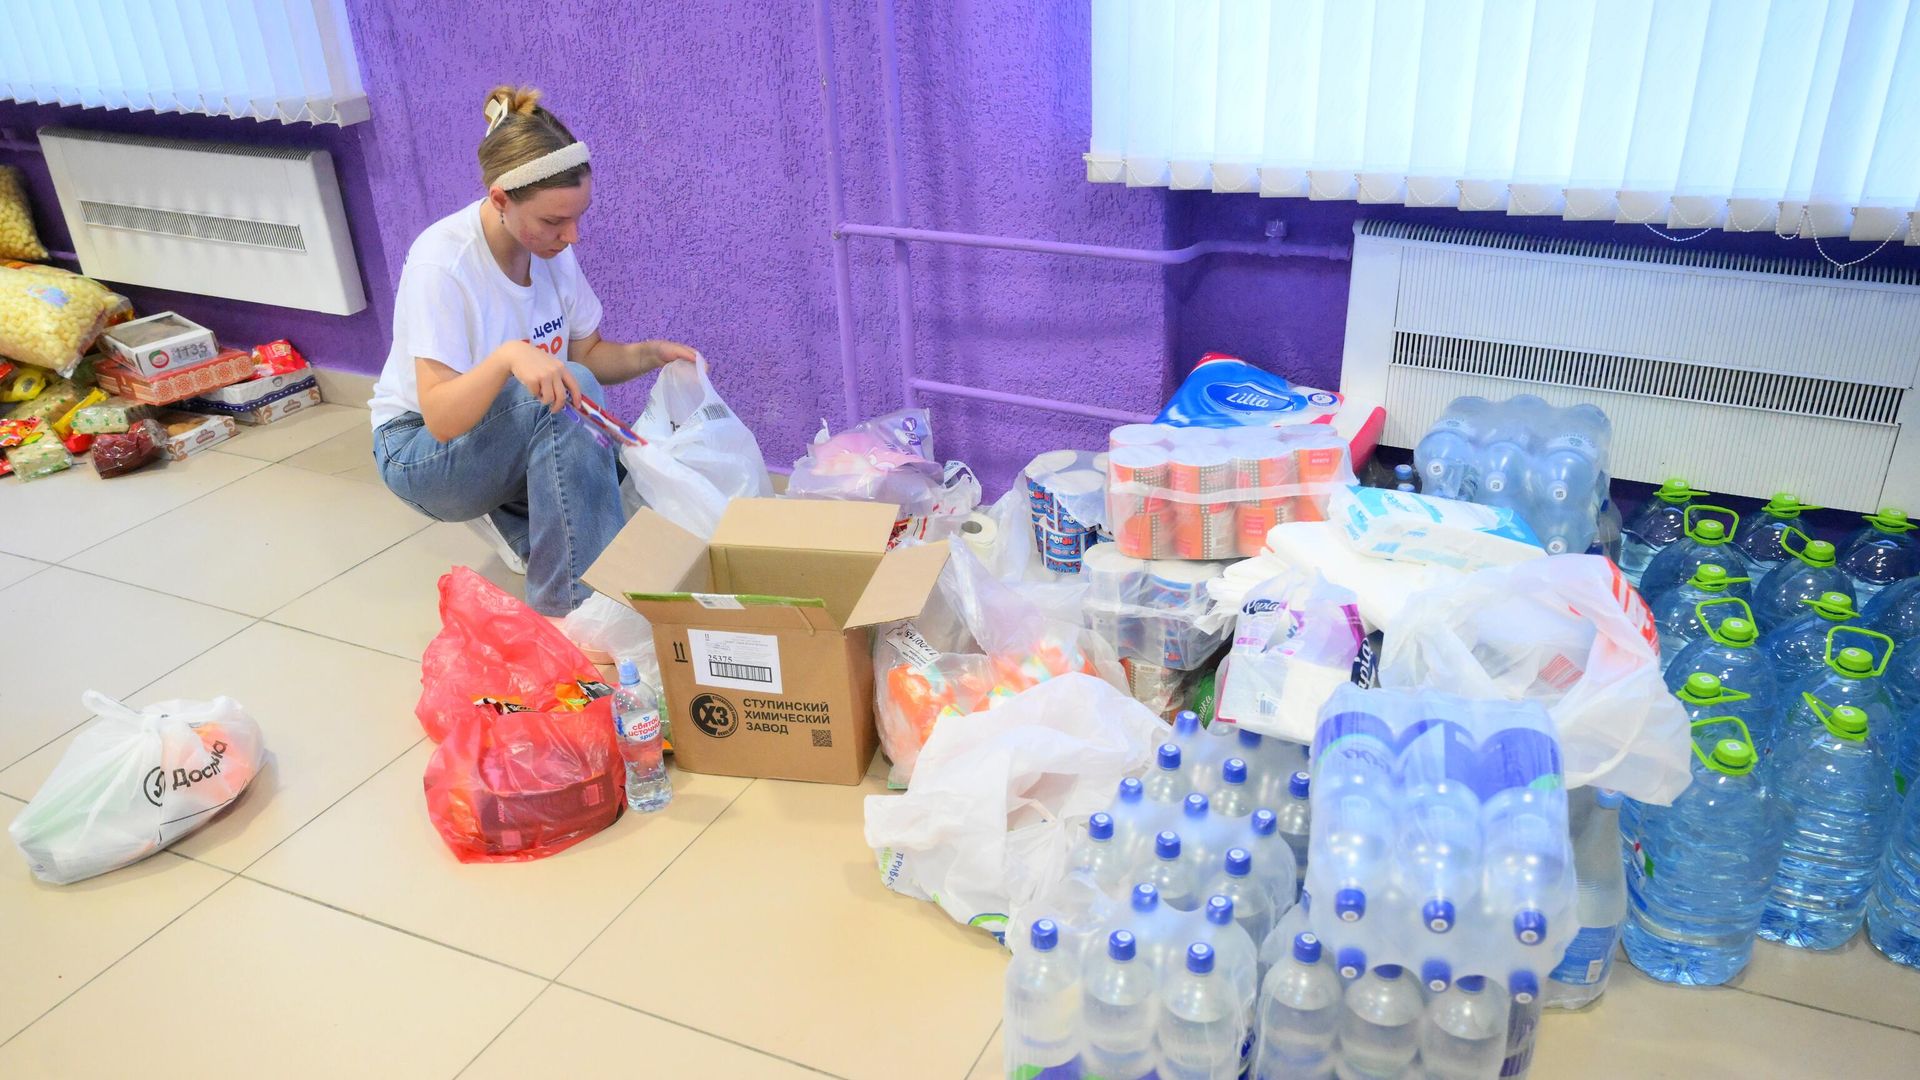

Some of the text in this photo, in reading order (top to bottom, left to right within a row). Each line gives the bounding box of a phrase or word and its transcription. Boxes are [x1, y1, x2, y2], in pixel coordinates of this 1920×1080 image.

[1226, 392, 1270, 408] Lilia
[743, 698, 829, 712] СТУПИНСКИЙ
[744, 709, 830, 724] ХИМИЧЕСКИЙ
[745, 721, 789, 735] ЗАВОД
